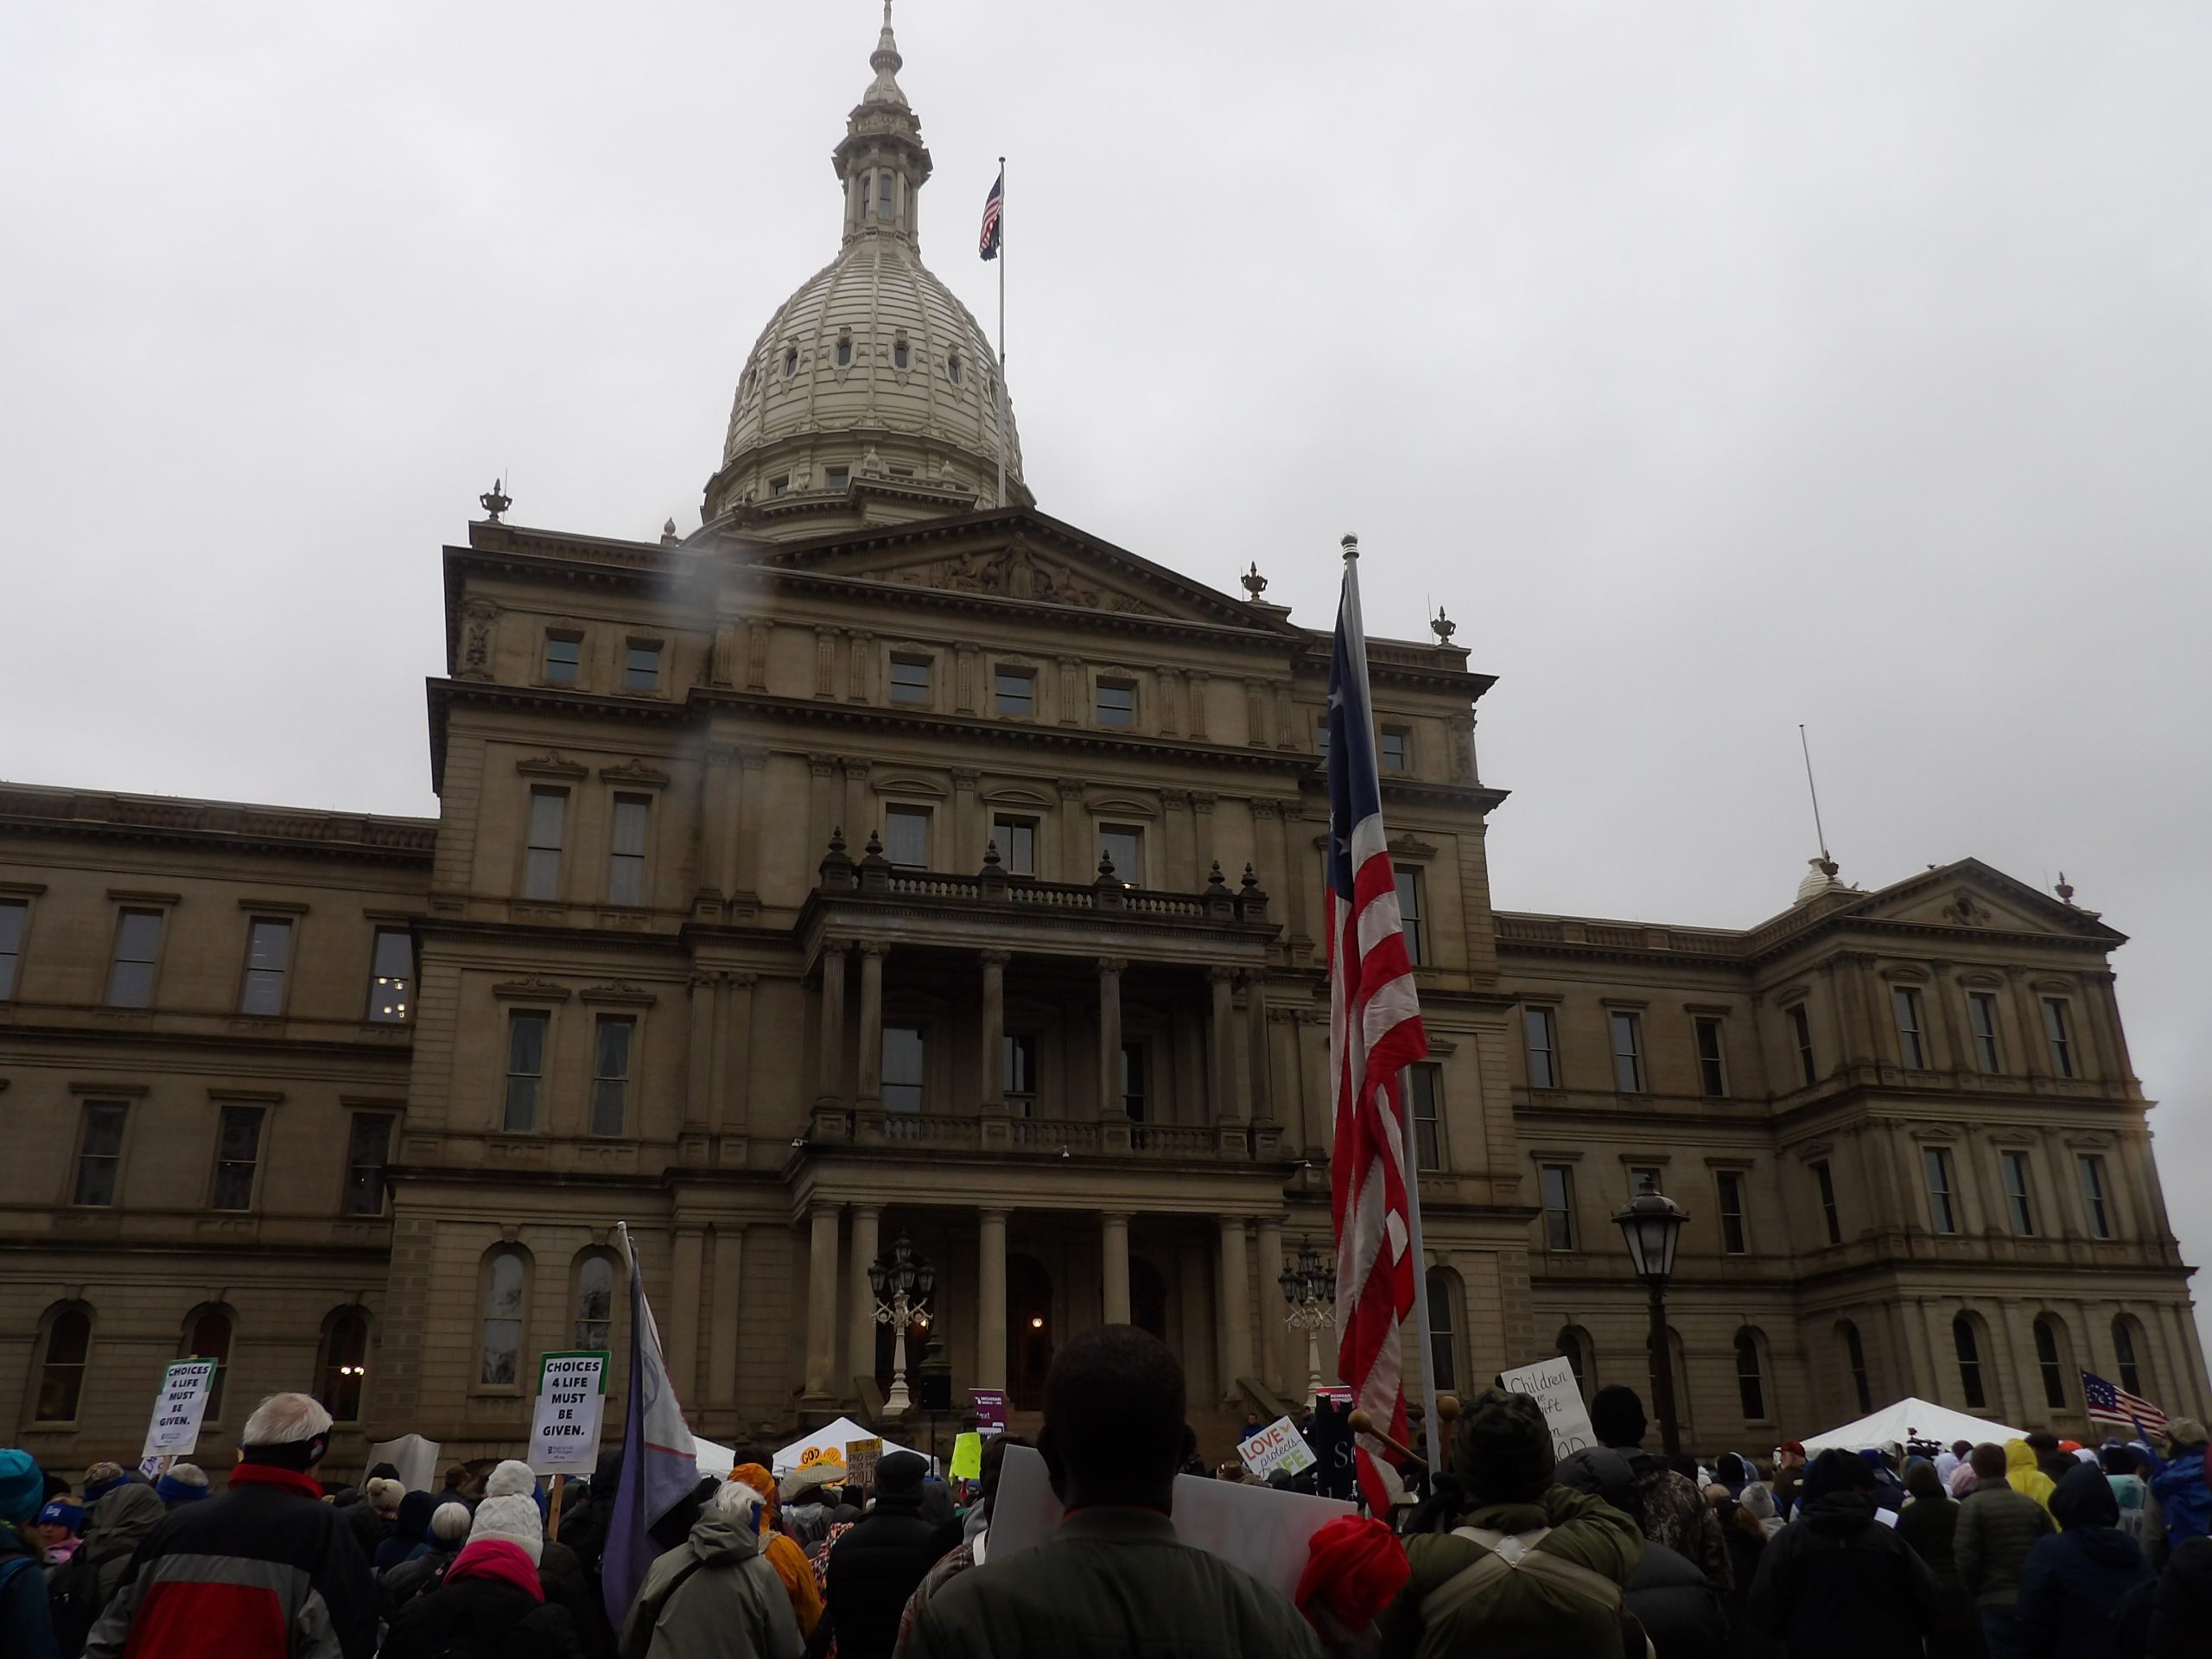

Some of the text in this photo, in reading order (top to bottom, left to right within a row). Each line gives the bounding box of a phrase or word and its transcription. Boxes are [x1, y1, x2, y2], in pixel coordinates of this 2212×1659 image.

[168, 1366, 209, 1376] CHOICES
[547, 1362, 600, 1372] CHOICES
[179, 1378, 199, 1388] LIFE
[552, 1377, 588, 1388] 4 LIFE
[1510, 1370, 1567, 1393] Children
[168, 1391, 195, 1401] MUST
[551, 1393, 586, 1404] MUST
[1537, 1394, 1547, 1402] re
[172, 1404, 183, 1413] BE
[558, 1409, 573, 1420] BE
[159, 1417, 190, 1427] GIVEN.
[543, 1425, 585, 1437] GIVEN.
[866, 1438, 881, 1451] AM
[1242, 1427, 1284, 1461] LOVE
[1555, 1437, 1586, 1462] OD
[802, 1448, 820, 1465] GOD
[849, 1452, 864, 1463] PRO
[1259, 1438, 1300, 1478] protects
[849, 1463, 864, 1472] PRO
[849, 1471, 864, 1484] PRO
